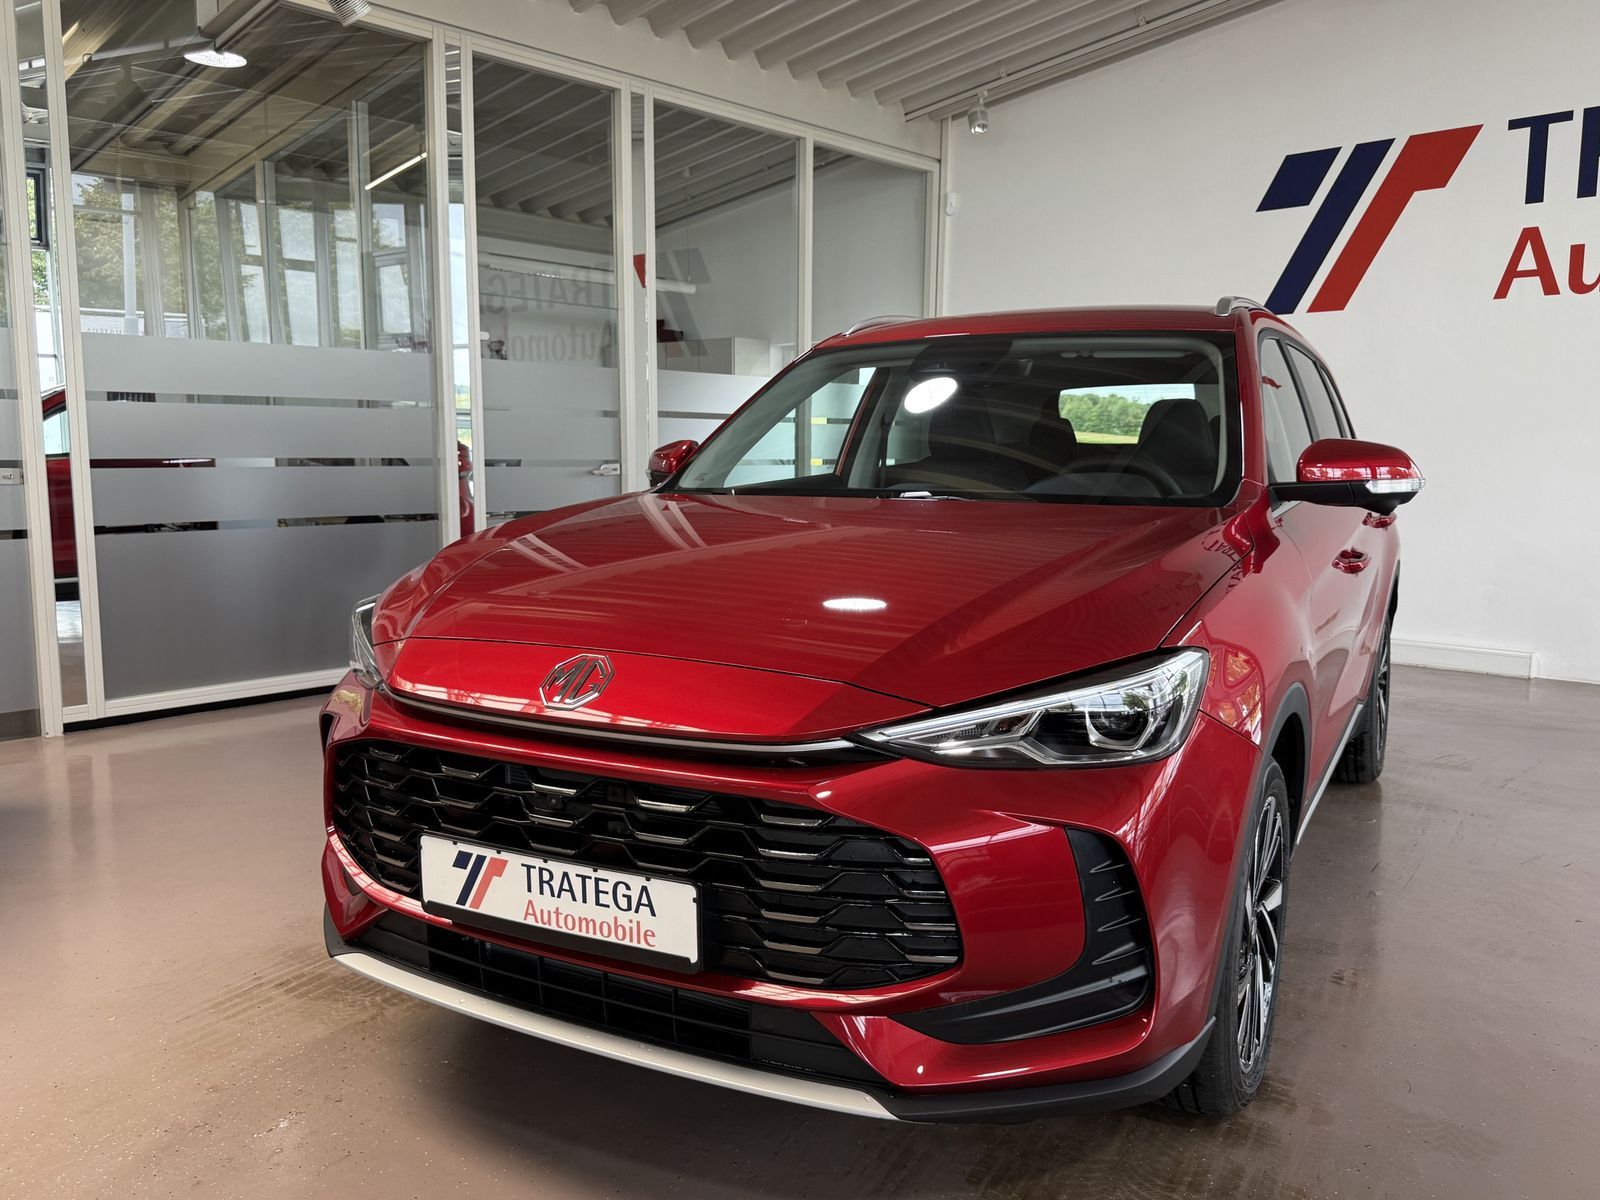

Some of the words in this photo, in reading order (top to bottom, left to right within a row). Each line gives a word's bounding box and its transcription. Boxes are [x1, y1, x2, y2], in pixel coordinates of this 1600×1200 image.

[543, 656, 609, 706] MG
[521, 863, 656, 917] TRATEGA
[523, 899, 656, 948] Automobile
